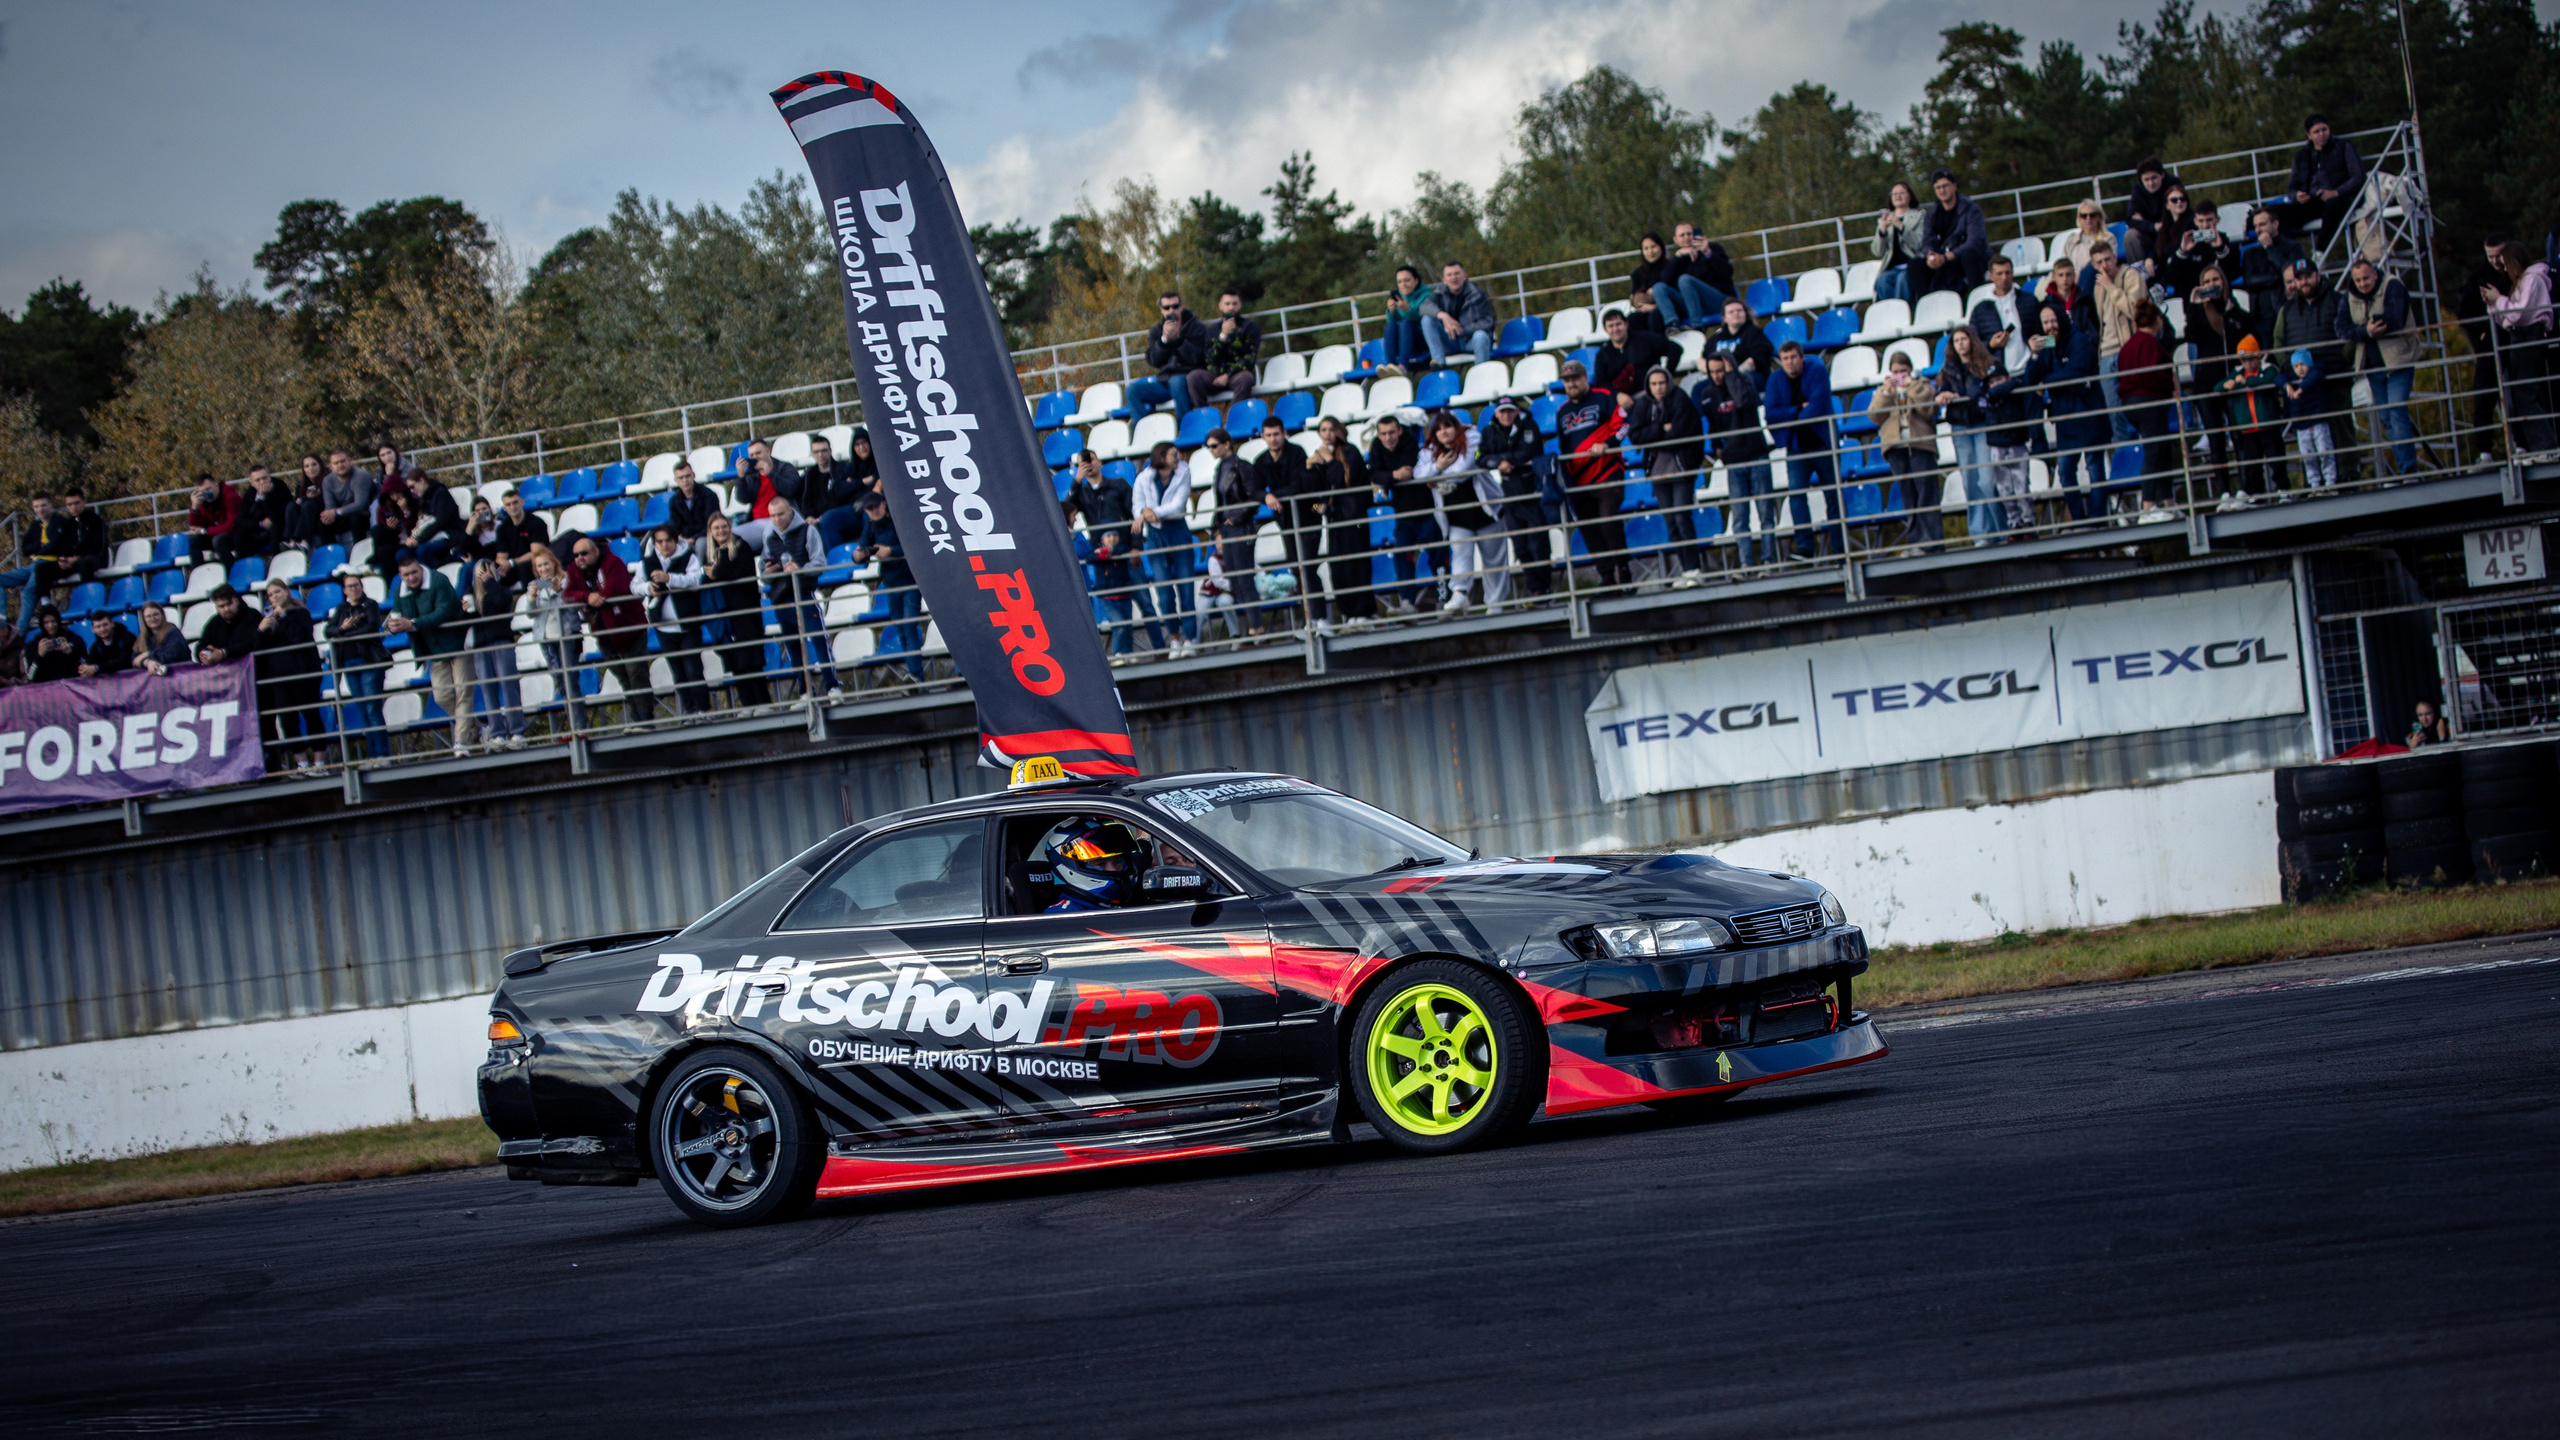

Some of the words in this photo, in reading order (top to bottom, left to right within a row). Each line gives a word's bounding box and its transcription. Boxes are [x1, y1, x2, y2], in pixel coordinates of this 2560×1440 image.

[834, 197, 877, 313] ШКОЛА
[857, 320, 920, 452] ДРИФТА
[860, 180, 1065, 697] Driftschool.PRO
[905, 459, 931, 480] В
[914, 487, 956, 554] МСК
[2479, 529, 2525, 556] MP
[2485, 554, 2527, 579] 4.5
[1600, 701, 1799, 748] TEXOL
[1832, 669, 2039, 716] TEXOL
[2072, 637, 2288, 684] TEXOL
[0, 700, 239, 787] FOREST
[1031, 763, 1058, 778] TAXI
[1029, 873, 1053, 883] BRID
[1163, 876, 1181, 889] DRIFT
[1181, 875, 1201, 887] BAZAR
[636, 953, 1219, 1062] Driftschool.PRO
[809, 1038, 910, 1066] ОБУЧЕНИЕ
[914, 1050, 992, 1072] ДРИФТУ
[997, 1056, 1011, 1074] В
[1016, 1057, 1100, 1080] МОСКВЕ
